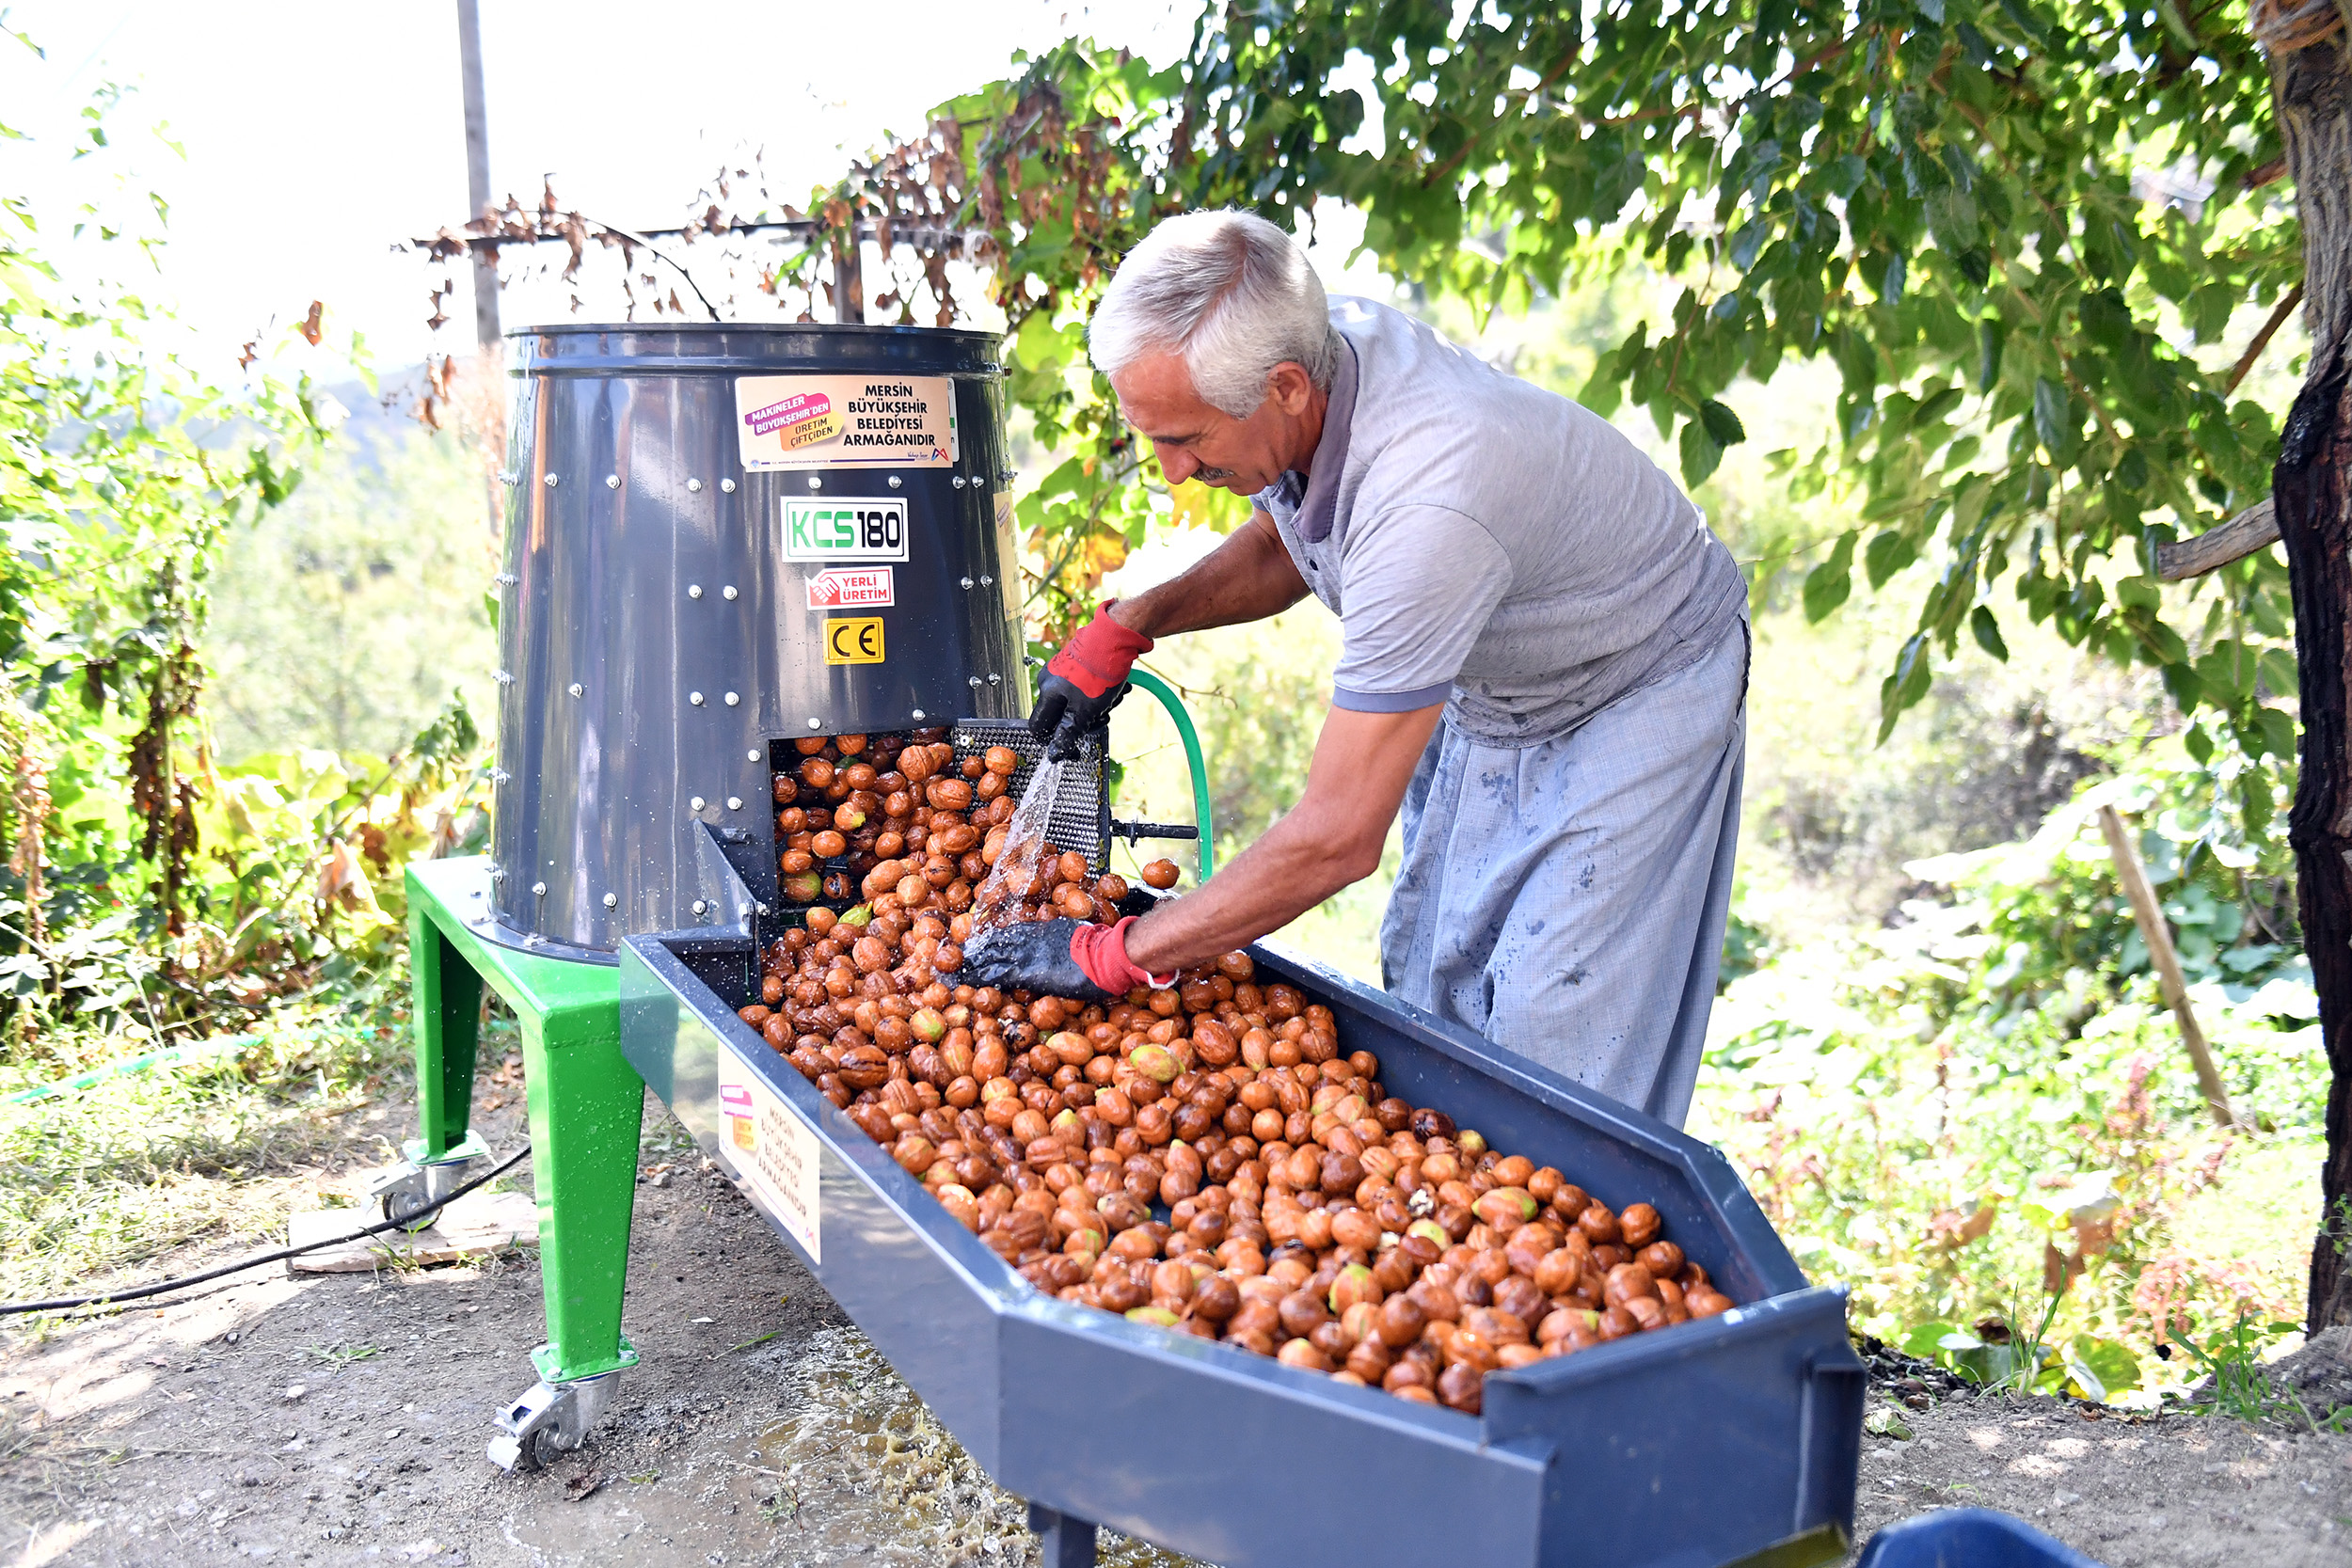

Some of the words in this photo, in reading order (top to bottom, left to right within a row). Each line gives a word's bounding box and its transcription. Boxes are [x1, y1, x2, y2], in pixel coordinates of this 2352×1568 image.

[866, 382, 913, 397] MERSİN
[849, 398, 928, 417] BÜYÜKŞEHİR
[857, 415, 923, 430] BELEDİYESİ
[843, 431, 936, 446] ARMAĞANIDIR
[843, 574, 877, 587] YERLİ
[843, 587, 887, 600] ÜRETİM
[833, 625, 876, 657] CE
